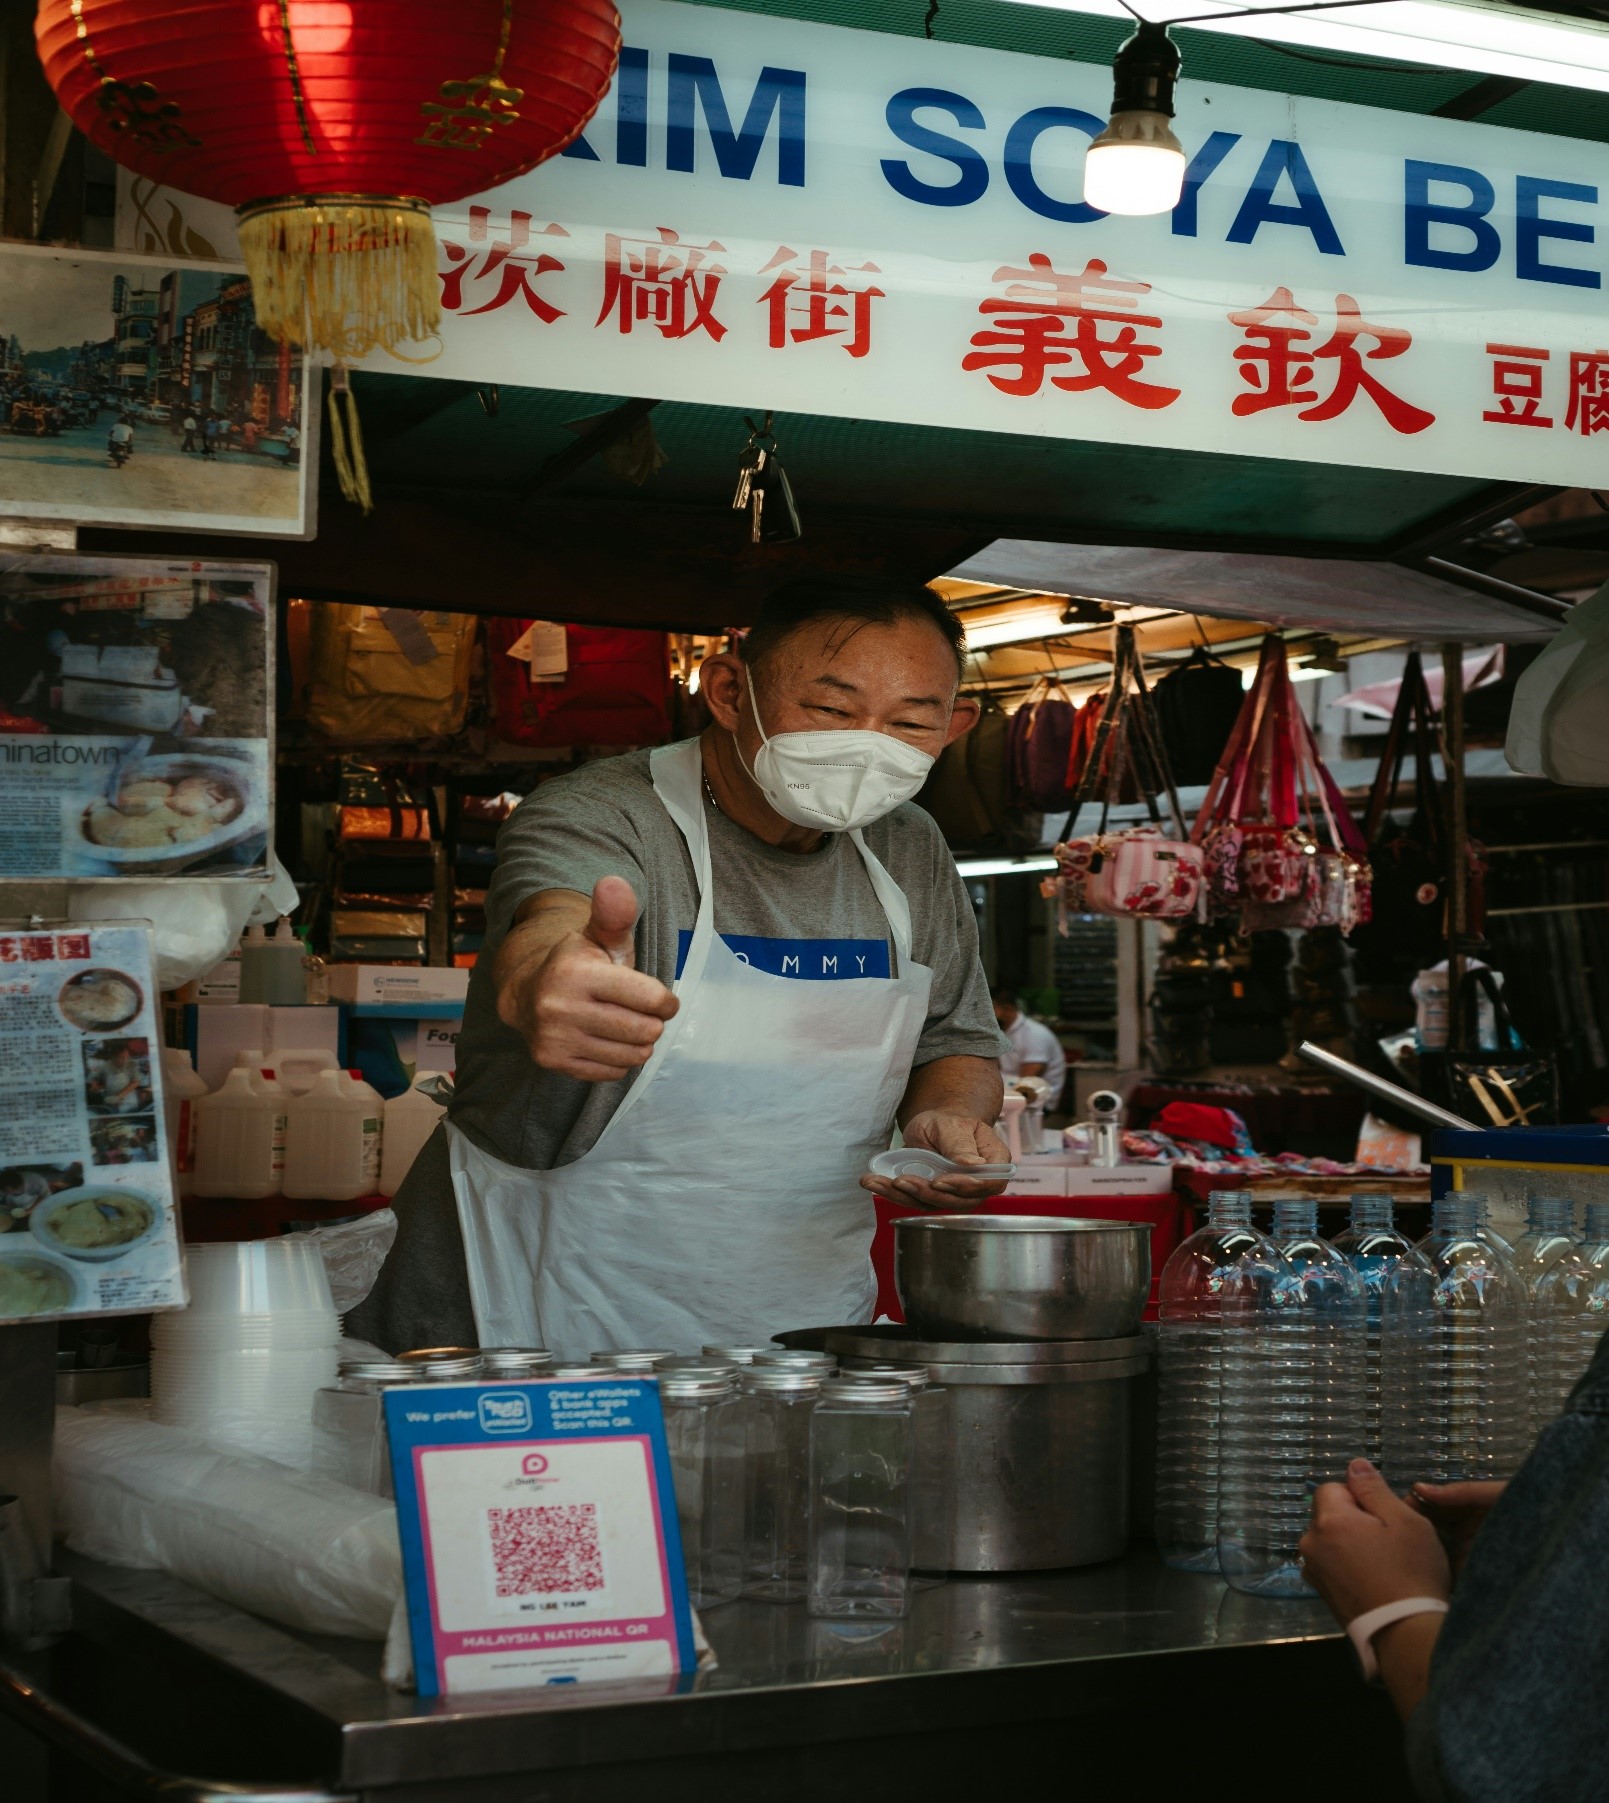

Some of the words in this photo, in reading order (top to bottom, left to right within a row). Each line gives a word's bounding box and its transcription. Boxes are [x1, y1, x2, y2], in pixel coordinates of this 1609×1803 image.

[560, 46, 806, 187] IM
[880, 87, 1346, 257] SOYA
[1404, 158, 1602, 290] BE
[438, 205, 886, 358] 茨廠街
[961, 252, 1436, 435] 義欽
[462, 1632, 542, 1648] MALAYSIA
[544, 1625, 623, 1641] NATIONAL
[625, 1623, 650, 1636] QR
